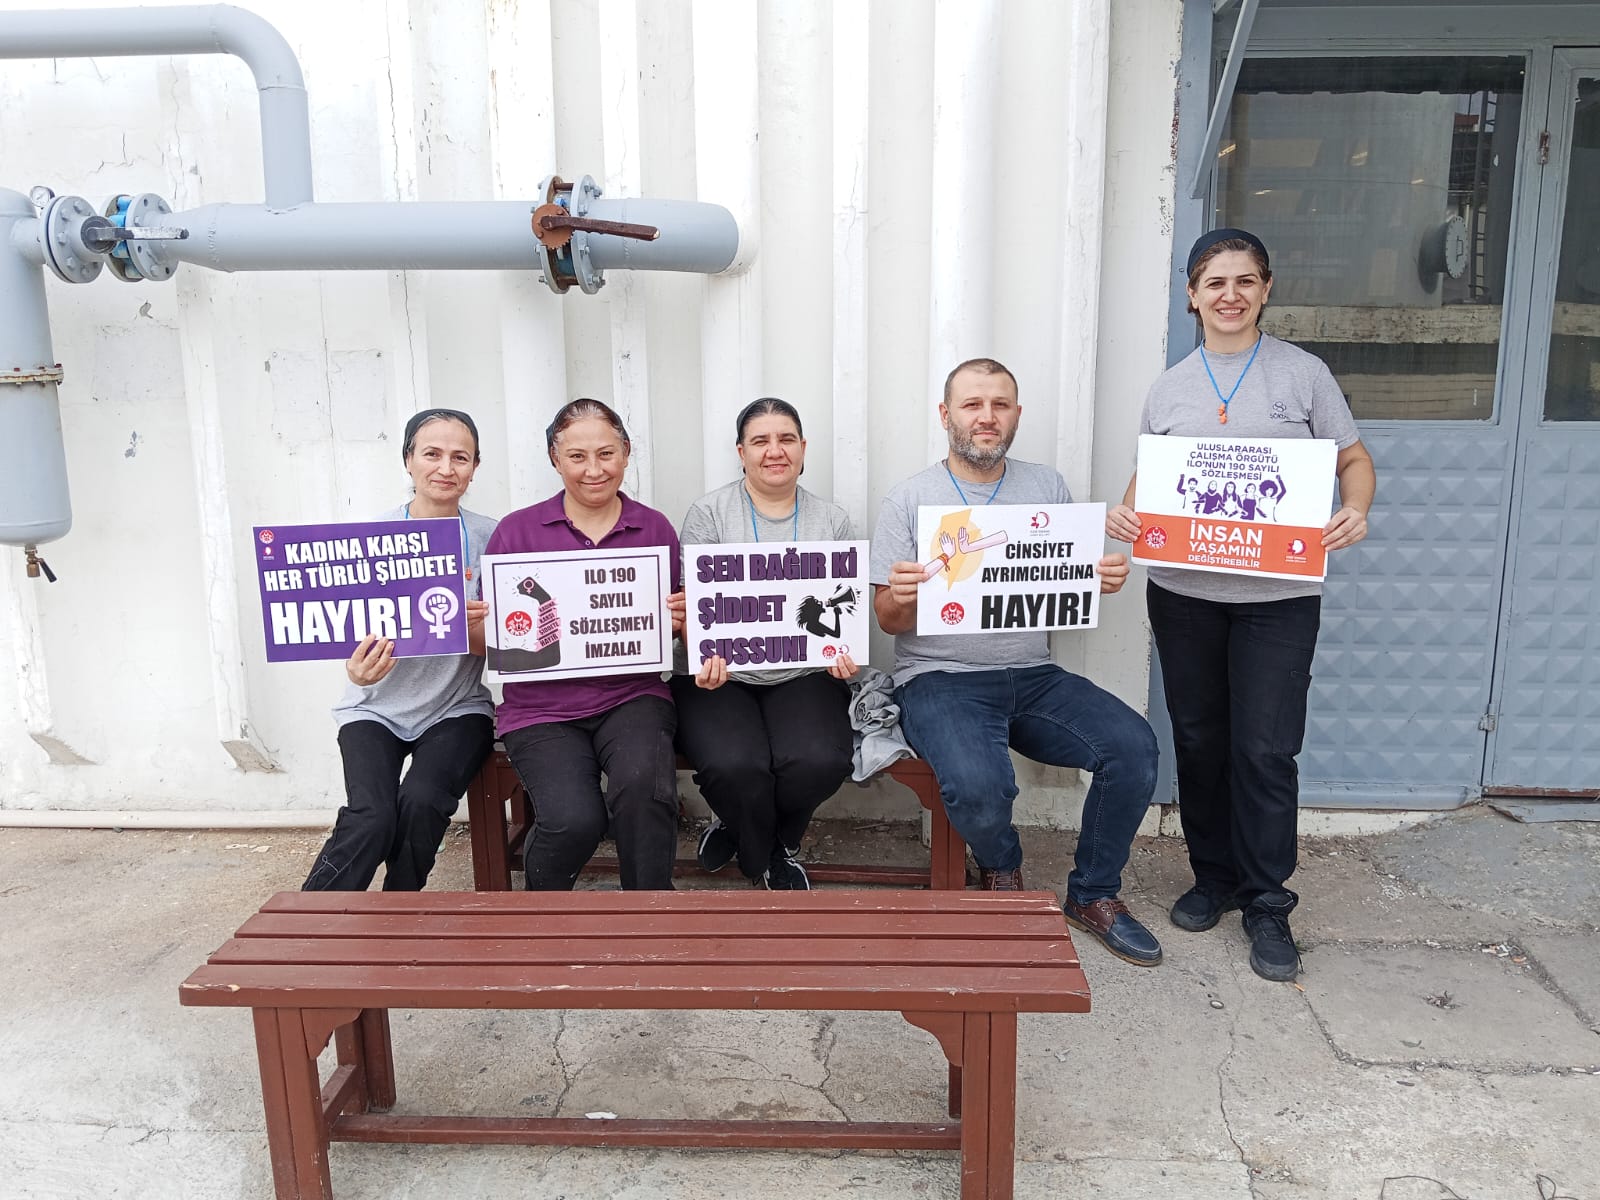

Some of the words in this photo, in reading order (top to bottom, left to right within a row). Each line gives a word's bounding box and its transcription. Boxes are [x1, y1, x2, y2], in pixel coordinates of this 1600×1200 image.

[1189, 451, 1232, 462] ÇALIŞMA
[1235, 452, 1278, 464] ÖRGÜTÜ
[1196, 443, 1272, 454] ULUSLARARASI
[1186, 460, 1226, 470] ILO'NUN
[1229, 462, 1246, 471] 190
[1248, 463, 1280, 473] SAYILI
[1201, 469, 1262, 481] SÖZLEŞMESİ
[1190, 519, 1263, 546] İNSAN
[285, 537, 364, 565] KADINA
[366, 532, 430, 558] KARŞI
[1005, 540, 1074, 560] CİNSİYET
[1188, 541, 1262, 559] YAŞAMINI
[697, 554, 745, 583] SEN
[750, 547, 827, 581] BAĞIR
[831, 547, 858, 579] Kİ
[1188, 554, 1260, 568] DEĞİŞTİREBİLİR
[263, 569, 303, 592] HER
[306, 559, 371, 589] TÜRLÜ
[375, 554, 458, 586] ŞİDDETE
[584, 569, 607, 585] ILO
[609, 567, 636, 583] 190
[981, 562, 1094, 583] AYRIMCILIĞINA
[589, 592, 633, 609] SAYILI
[981, 591, 1092, 630] HAYIR!
[270, 596, 413, 645] HAYIR!
[698, 592, 787, 630] ŞİDDET
[569, 613, 654, 636] SÖZLEŞMEYİ
[585, 641, 642, 658] İMZALA!
[699, 635, 808, 666] SUSSUN!
